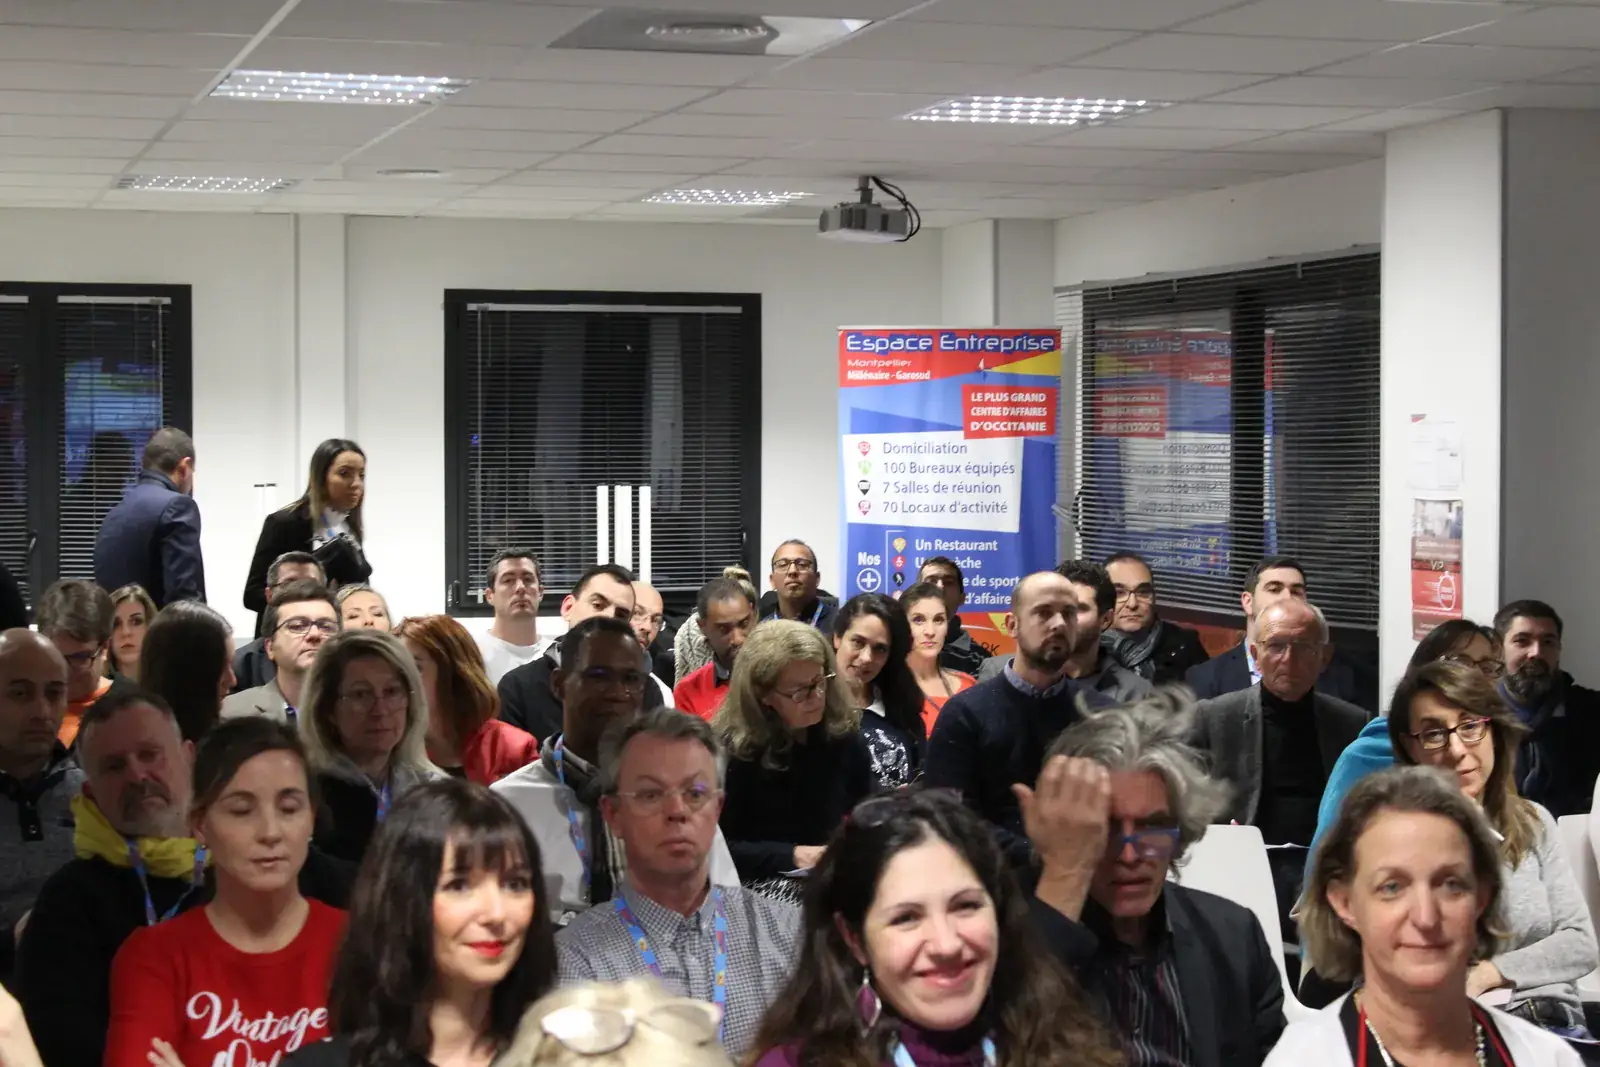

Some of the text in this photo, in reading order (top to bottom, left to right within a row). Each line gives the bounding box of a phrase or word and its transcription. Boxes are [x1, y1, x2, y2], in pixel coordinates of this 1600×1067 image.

[847, 334, 1054, 353] Espace Entreprise
[847, 359, 912, 368] Montpellier
[847, 369, 890, 380] Millénaire
[896, 369, 931, 380] Garosud
[971, 392, 1047, 403] LE PLUS GRAND
[971, 407, 1048, 417] CENTRE D'AFFAIRES
[970, 421, 1047, 432] D'OCCITANIE
[883, 442, 968, 454] Domiciliation
[884, 461, 1016, 477] 100 Bureaux équipés
[882, 481, 1002, 494] 7 Salles de réunion
[883, 500, 1008, 514] 70 Locaux d'activité
[915, 538, 998, 551] Un Restaurant
[857, 551, 882, 567] Nos
[955, 556, 982, 569] èche
[971, 574, 986, 587] de
[989, 576, 1020, 590] sport
[186, 991, 328, 1053] Vintage
